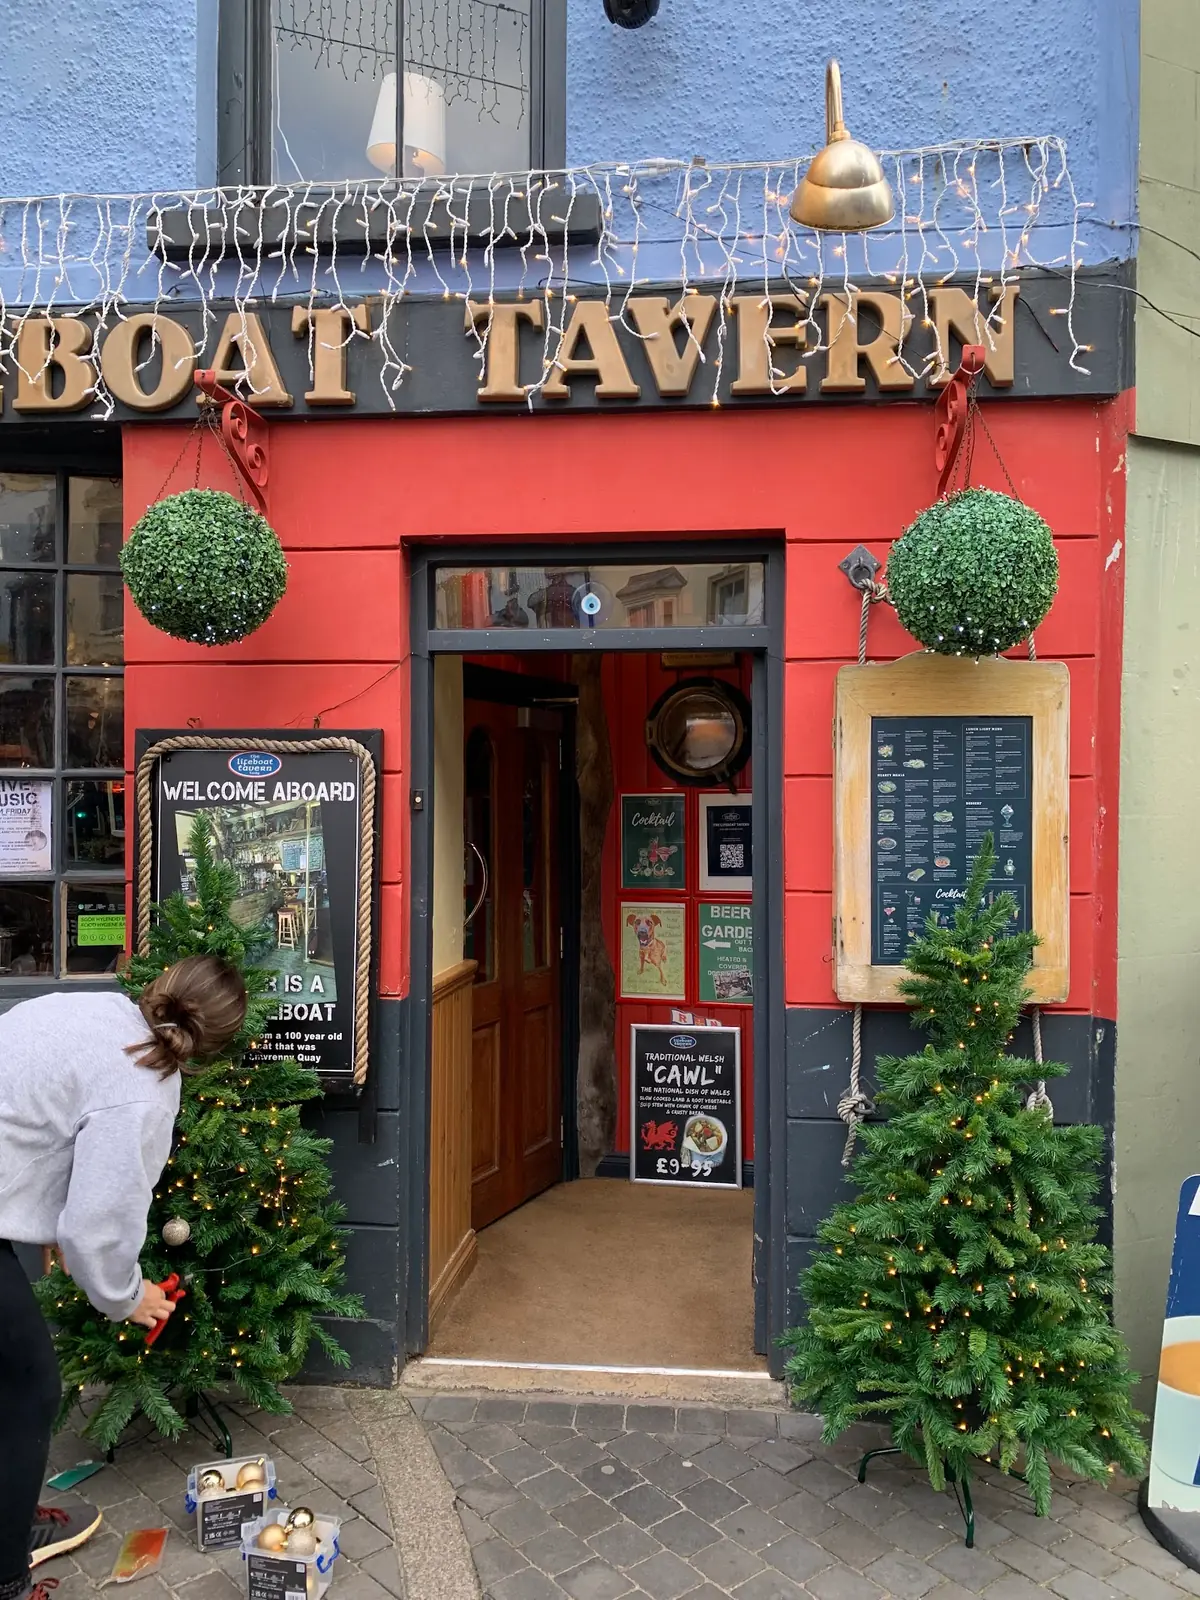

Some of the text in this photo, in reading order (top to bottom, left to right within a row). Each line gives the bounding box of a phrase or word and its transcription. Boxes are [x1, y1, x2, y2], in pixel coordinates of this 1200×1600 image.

[0, 286, 1021, 413] BOAT TAVERN
[237, 758, 273, 766] lifeboat
[0, 780, 30, 792] IVE
[163, 781, 355, 801] WELCOME ABOARD
[0, 792, 37, 806] USIC
[631, 811, 675, 827] Cocktail
[710, 905, 751, 919] BEER
[701, 924, 753, 939] GARDE
[284, 974, 303, 993] IS
[310, 974, 325, 993] A
[266, 1003, 336, 1021] BOAT
[285, 1032, 302, 1040] 100
[304, 1033, 325, 1041] year
[327, 1032, 343, 1040] old
[275, 1043, 294, 1051] that
[297, 1053, 321, 1063] Quay
[645, 1052, 725, 1063] TRADITIONAL WELSH
